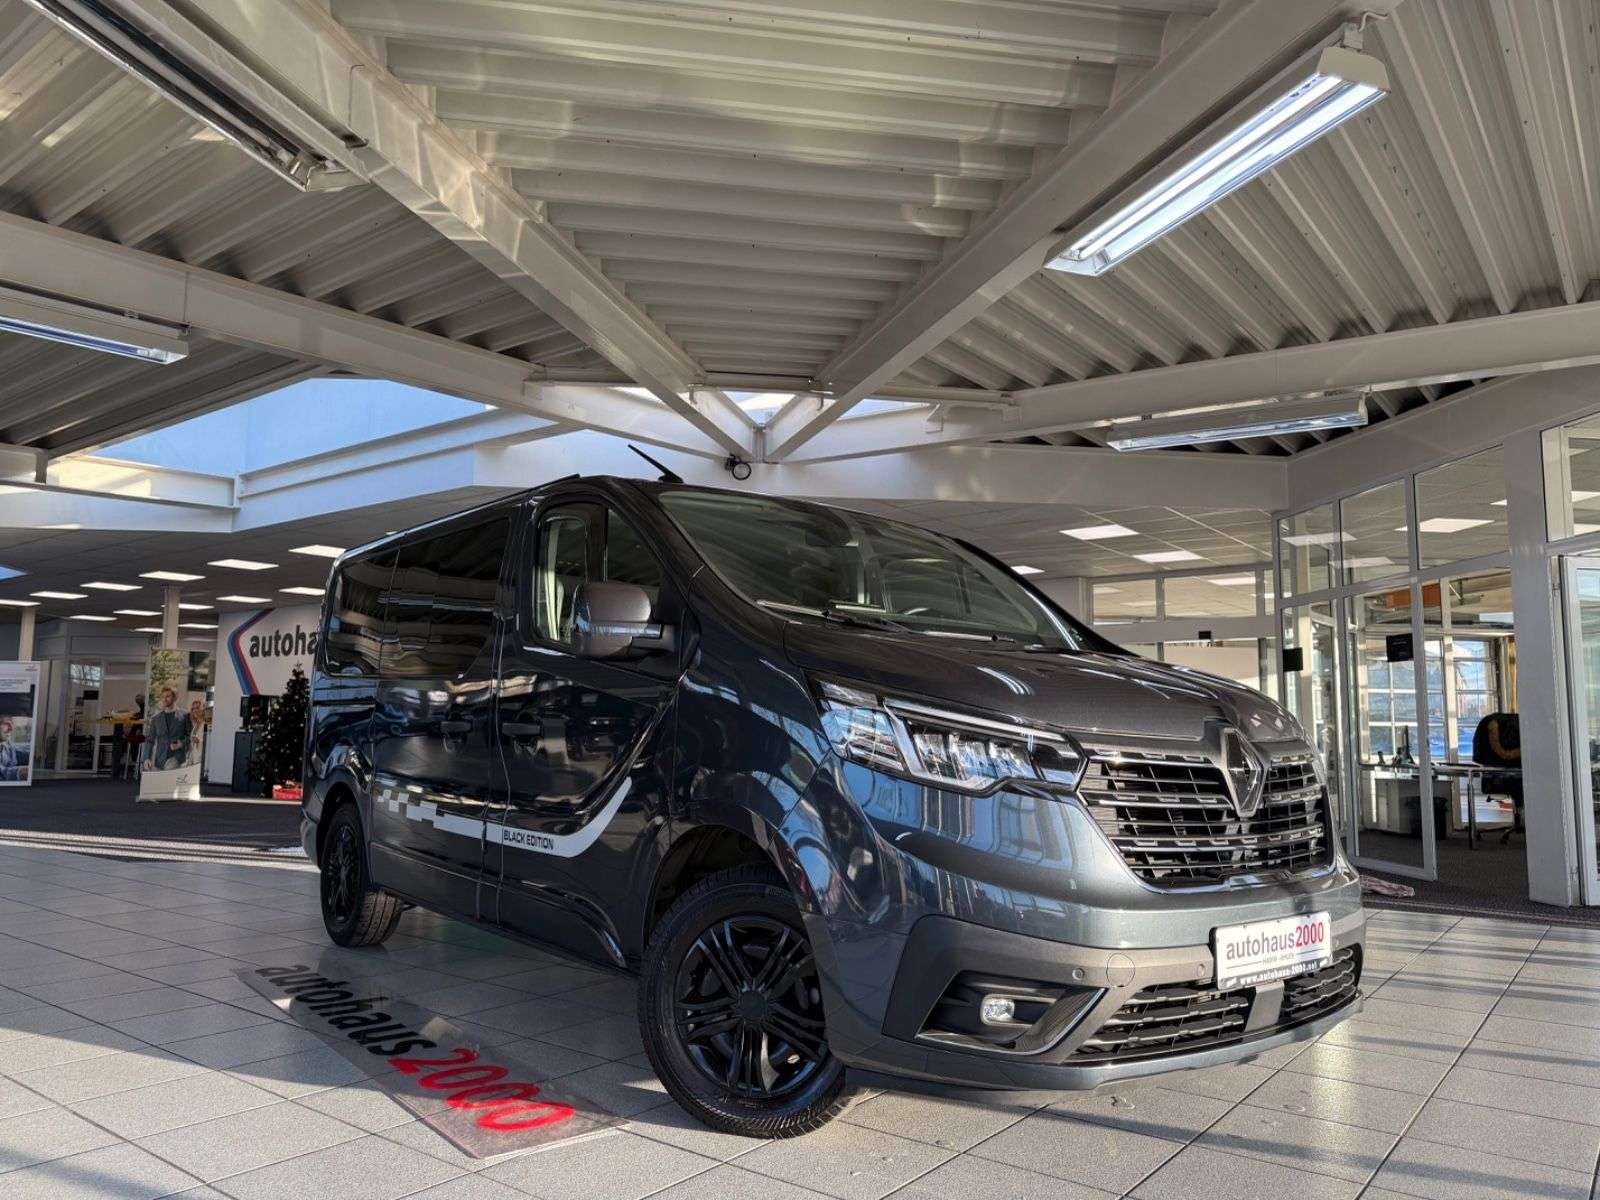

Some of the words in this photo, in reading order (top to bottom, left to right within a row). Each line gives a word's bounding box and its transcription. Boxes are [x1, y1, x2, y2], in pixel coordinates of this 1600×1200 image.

[503, 829, 526, 846] BLACK
[526, 833, 554, 850] EDITION
[1226, 922, 1324, 960] autohaus2000
[254, 964, 576, 1132] autohaus2000
